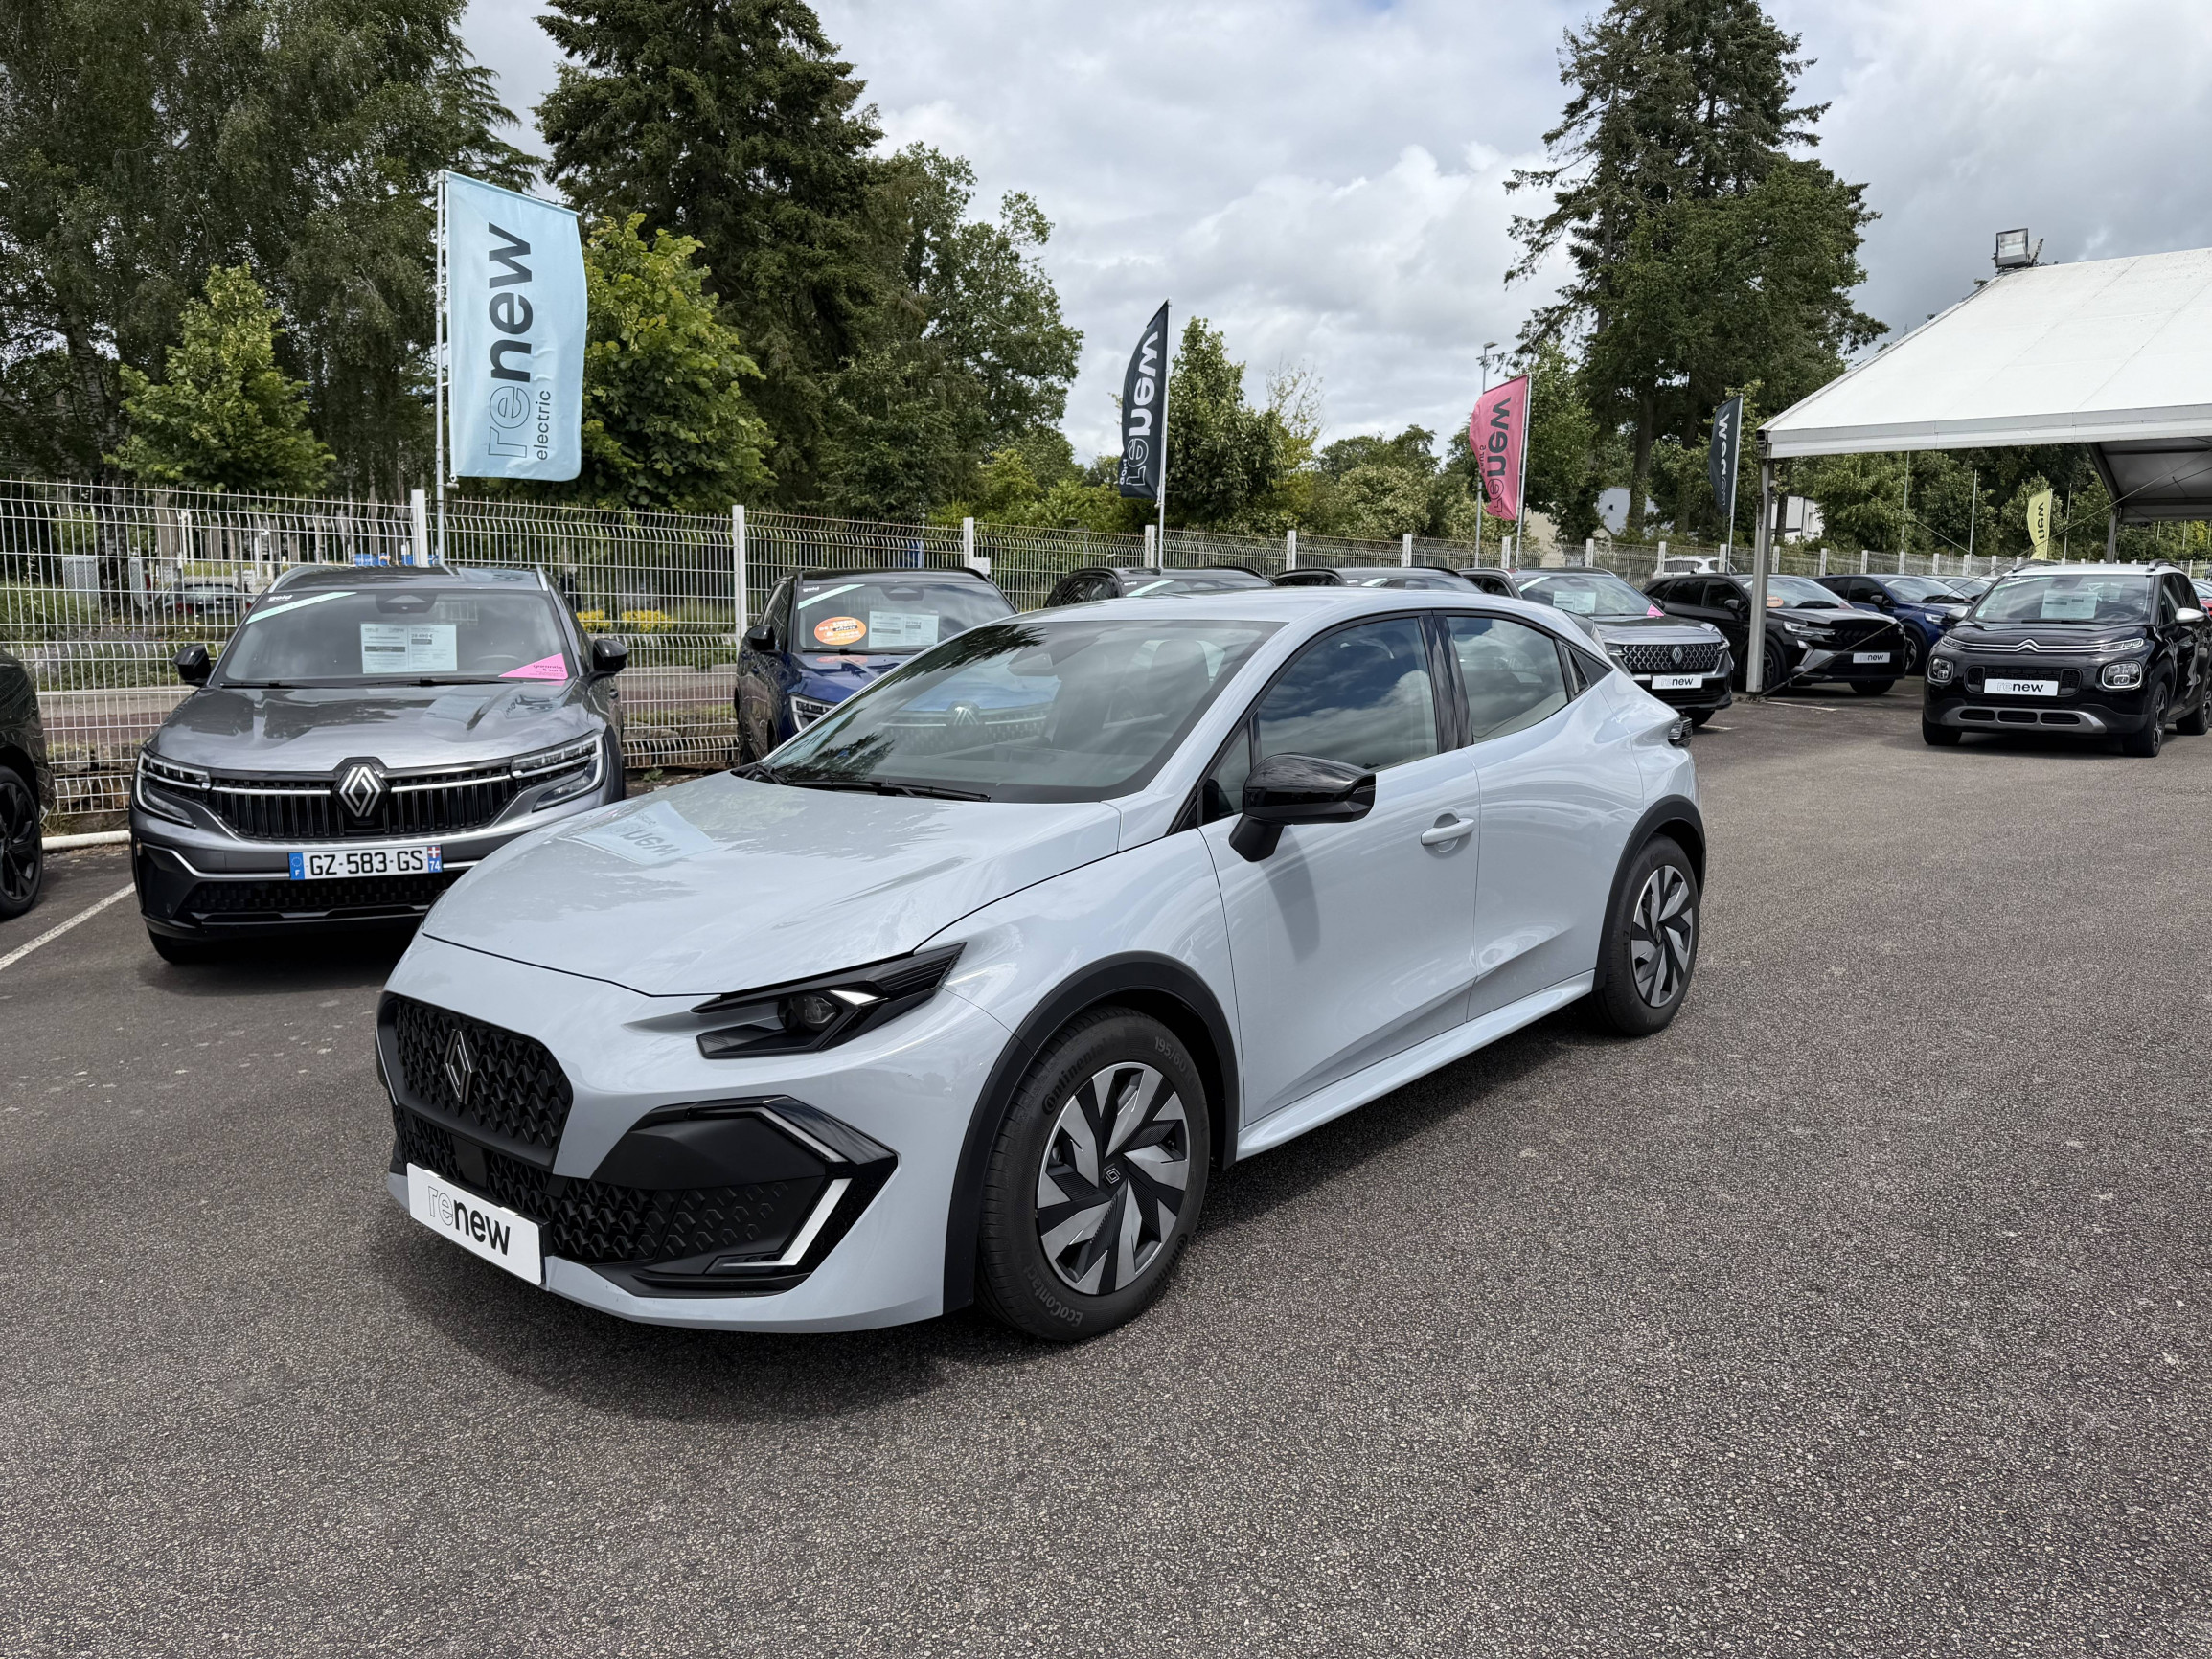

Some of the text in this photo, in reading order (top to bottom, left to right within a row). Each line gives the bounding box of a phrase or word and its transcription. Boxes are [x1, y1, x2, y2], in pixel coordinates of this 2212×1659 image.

[488, 221, 534, 459] renew
[533, 390, 552, 461] electric
[1996, 682, 2044, 693] renew
[309, 850, 423, 876] GZ-583-GS
[429, 860, 441, 872] 74
[428, 1185, 511, 1256] renew
